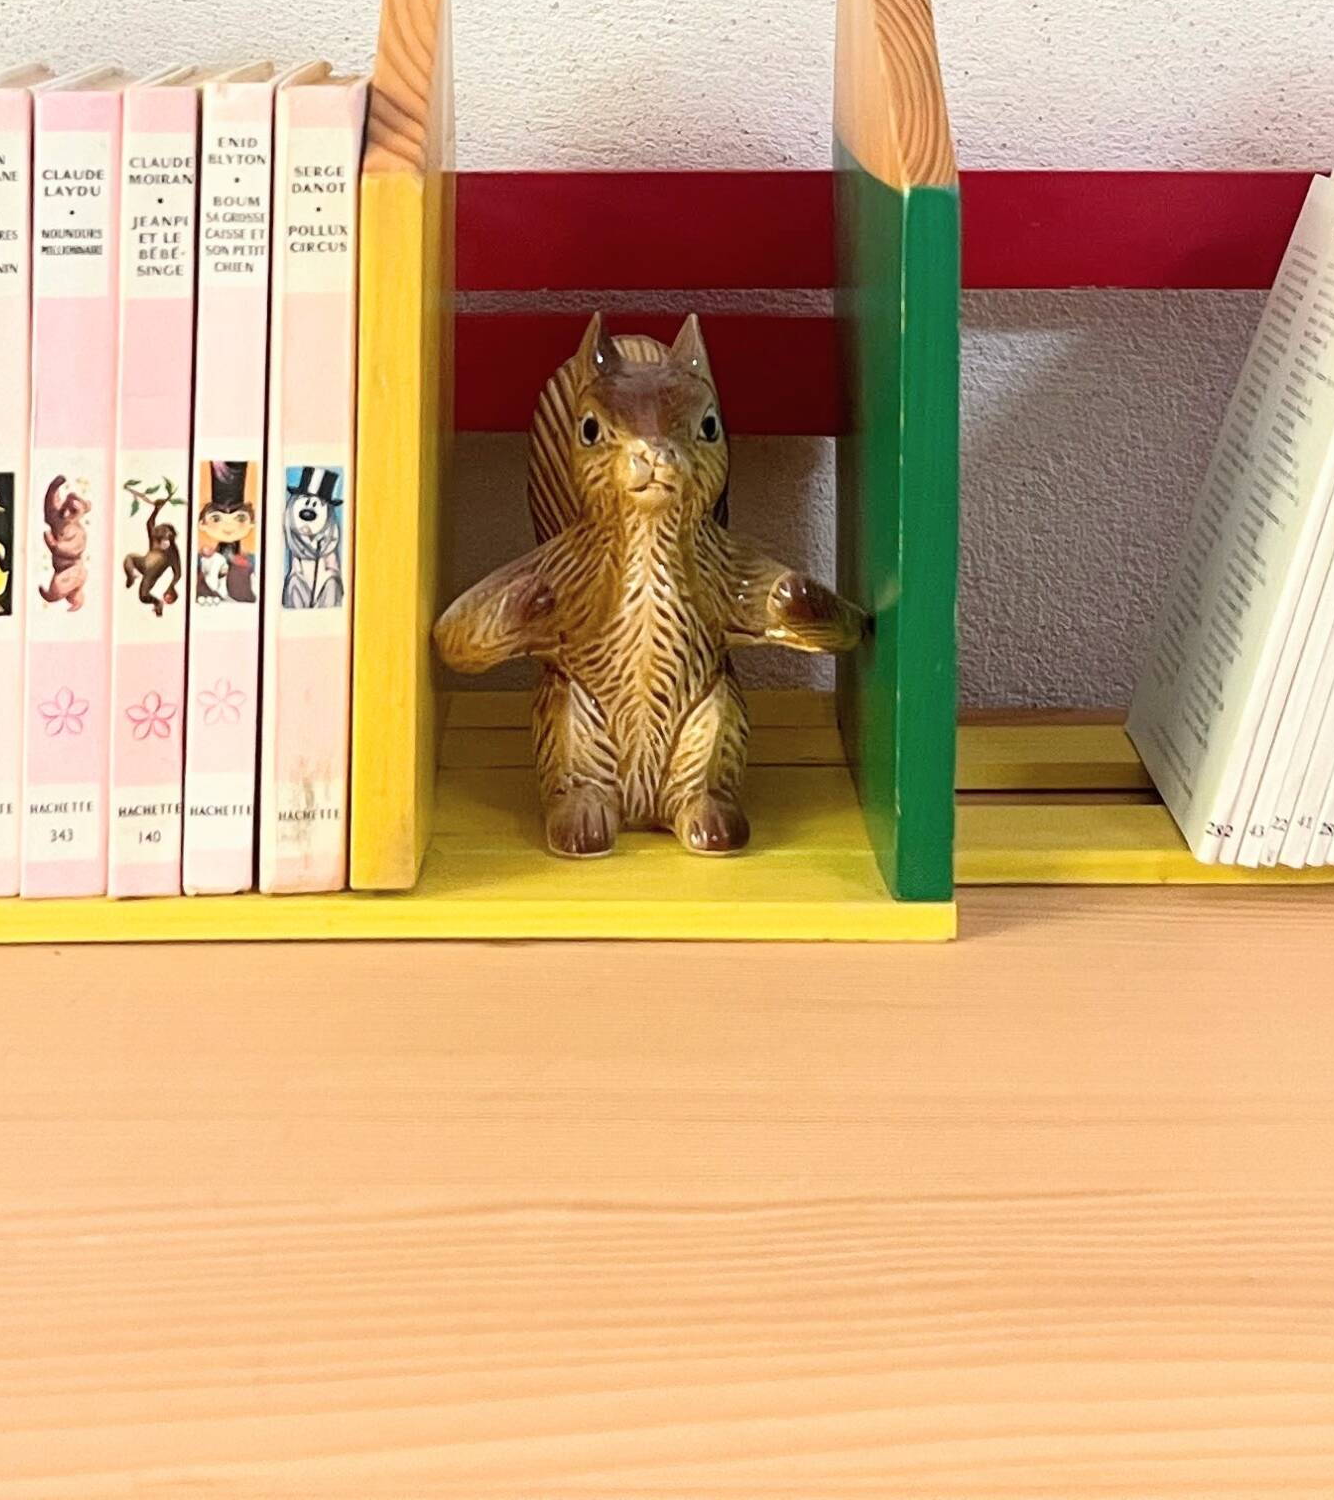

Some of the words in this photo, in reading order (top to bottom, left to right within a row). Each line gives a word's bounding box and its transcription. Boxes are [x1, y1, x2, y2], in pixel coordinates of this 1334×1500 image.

[217, 137, 258, 148] ENID
[129, 157, 194, 169] CLAUDE
[208, 154, 267, 165] BLYTON
[42, 169, 104, 181] CLAUDE
[294, 166, 344, 178] SERGE
[128, 174, 194, 185] MOIRAN
[44, 186, 102, 197] LAYDU
[291, 182, 346, 194] DANOT
[212, 196, 261, 207] BOUM
[205, 212, 219, 223] SA
[41, 228, 103, 240] NOUNOURS
[205, 228, 245, 240] CAISSE
[250, 229, 265, 240] ET
[288, 225, 348, 237] POLLUX
[138, 232, 157, 244] ET
[163, 232, 182, 244] LE
[205, 245, 230, 256] SON
[232, 245, 266, 256] PETIT
[289, 241, 348, 253] CIRCUS
[137, 264, 184, 277] SINGE
[214, 261, 254, 273] CHIEN
[29, 801, 95, 815] HACHETTE
[118, 802, 181, 818] HACHETTE
[190, 803, 252, 817] HACHETTE
[278, 808, 340, 821] HACHETTE
[50, 828, 74, 843] 343
[138, 830, 162, 844] 140
